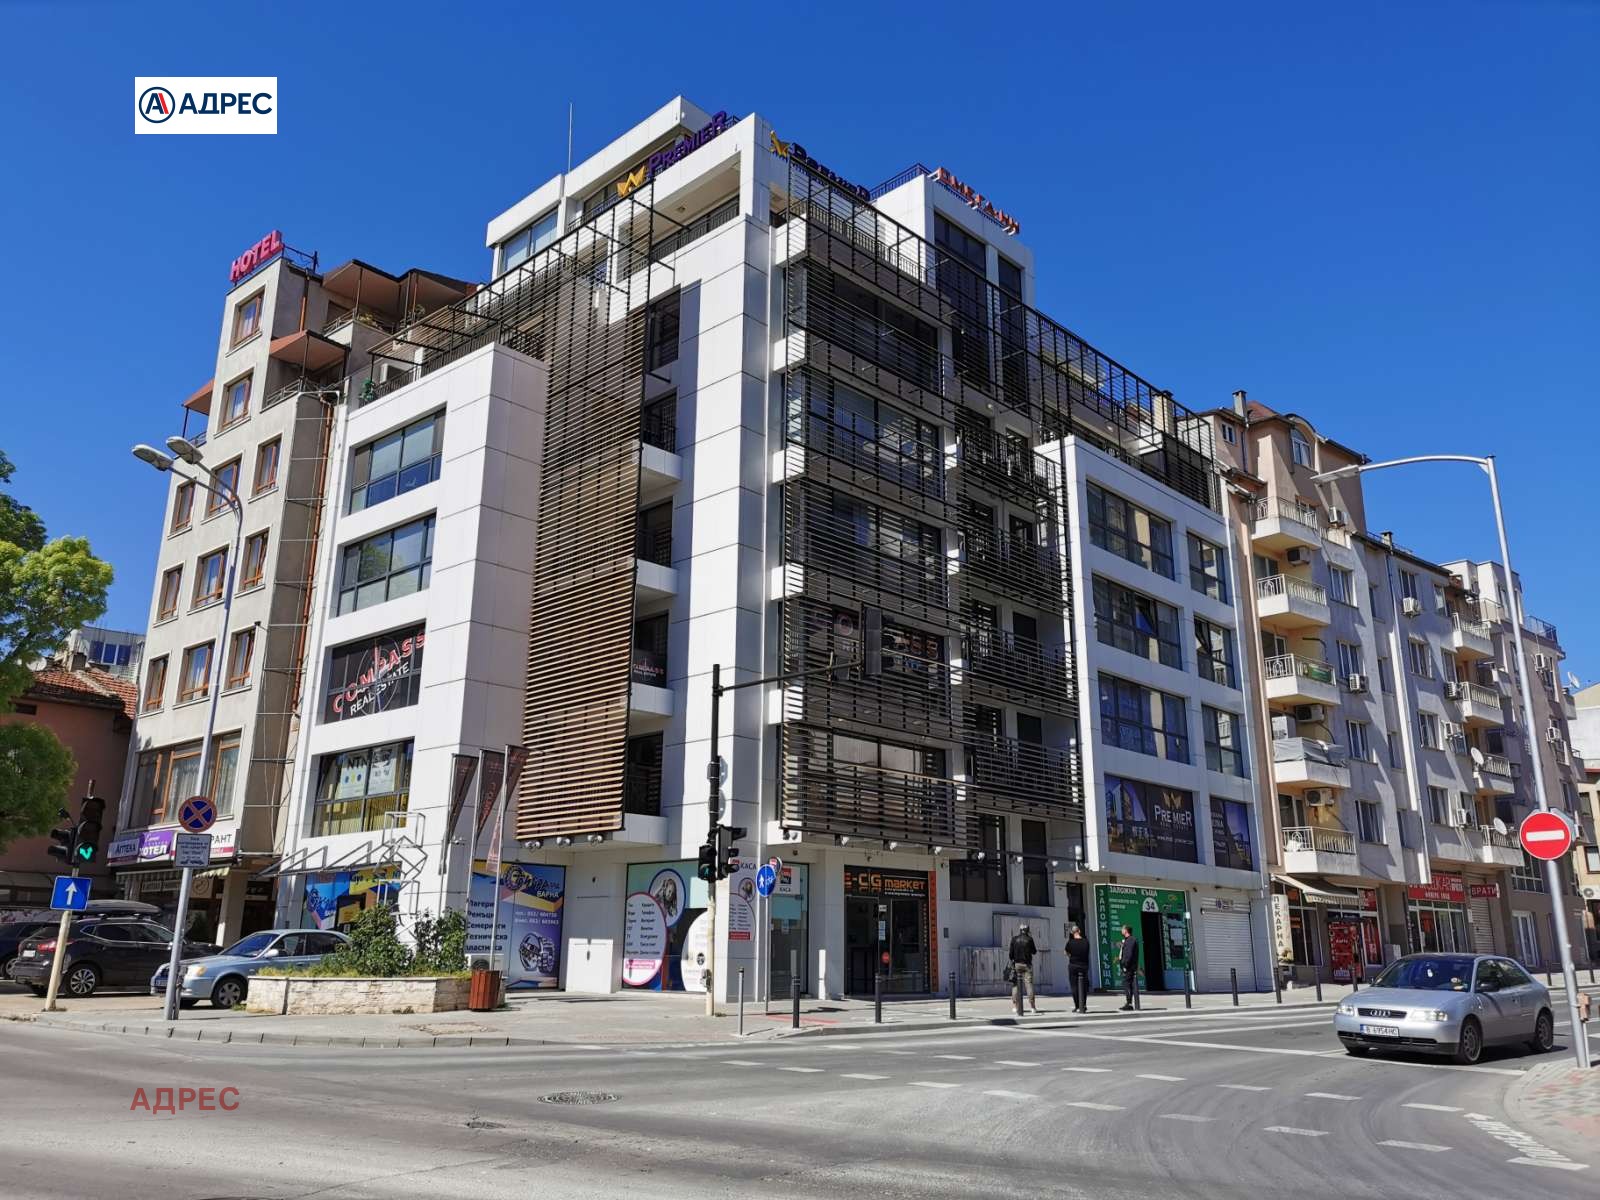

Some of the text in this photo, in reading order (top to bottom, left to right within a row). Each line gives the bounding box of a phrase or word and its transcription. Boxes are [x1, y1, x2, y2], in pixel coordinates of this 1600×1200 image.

[648, 111, 727, 178] PREMIER
[229, 229, 284, 283] HOTEL
[333, 631, 426, 713] COMPASS
[350, 692, 375, 716] REAL
[1154, 804, 1193, 827] PREMIER
[211, 833, 233, 844] РАНТ
[1145, 901, 1156, 911] 34
[1471, 885, 1496, 896] ВРАТИ
[1099, 889, 1112, 986] ЗАЛОЖНА КЪЩА
[1273, 896, 1284, 947] ПЕКАРНА
